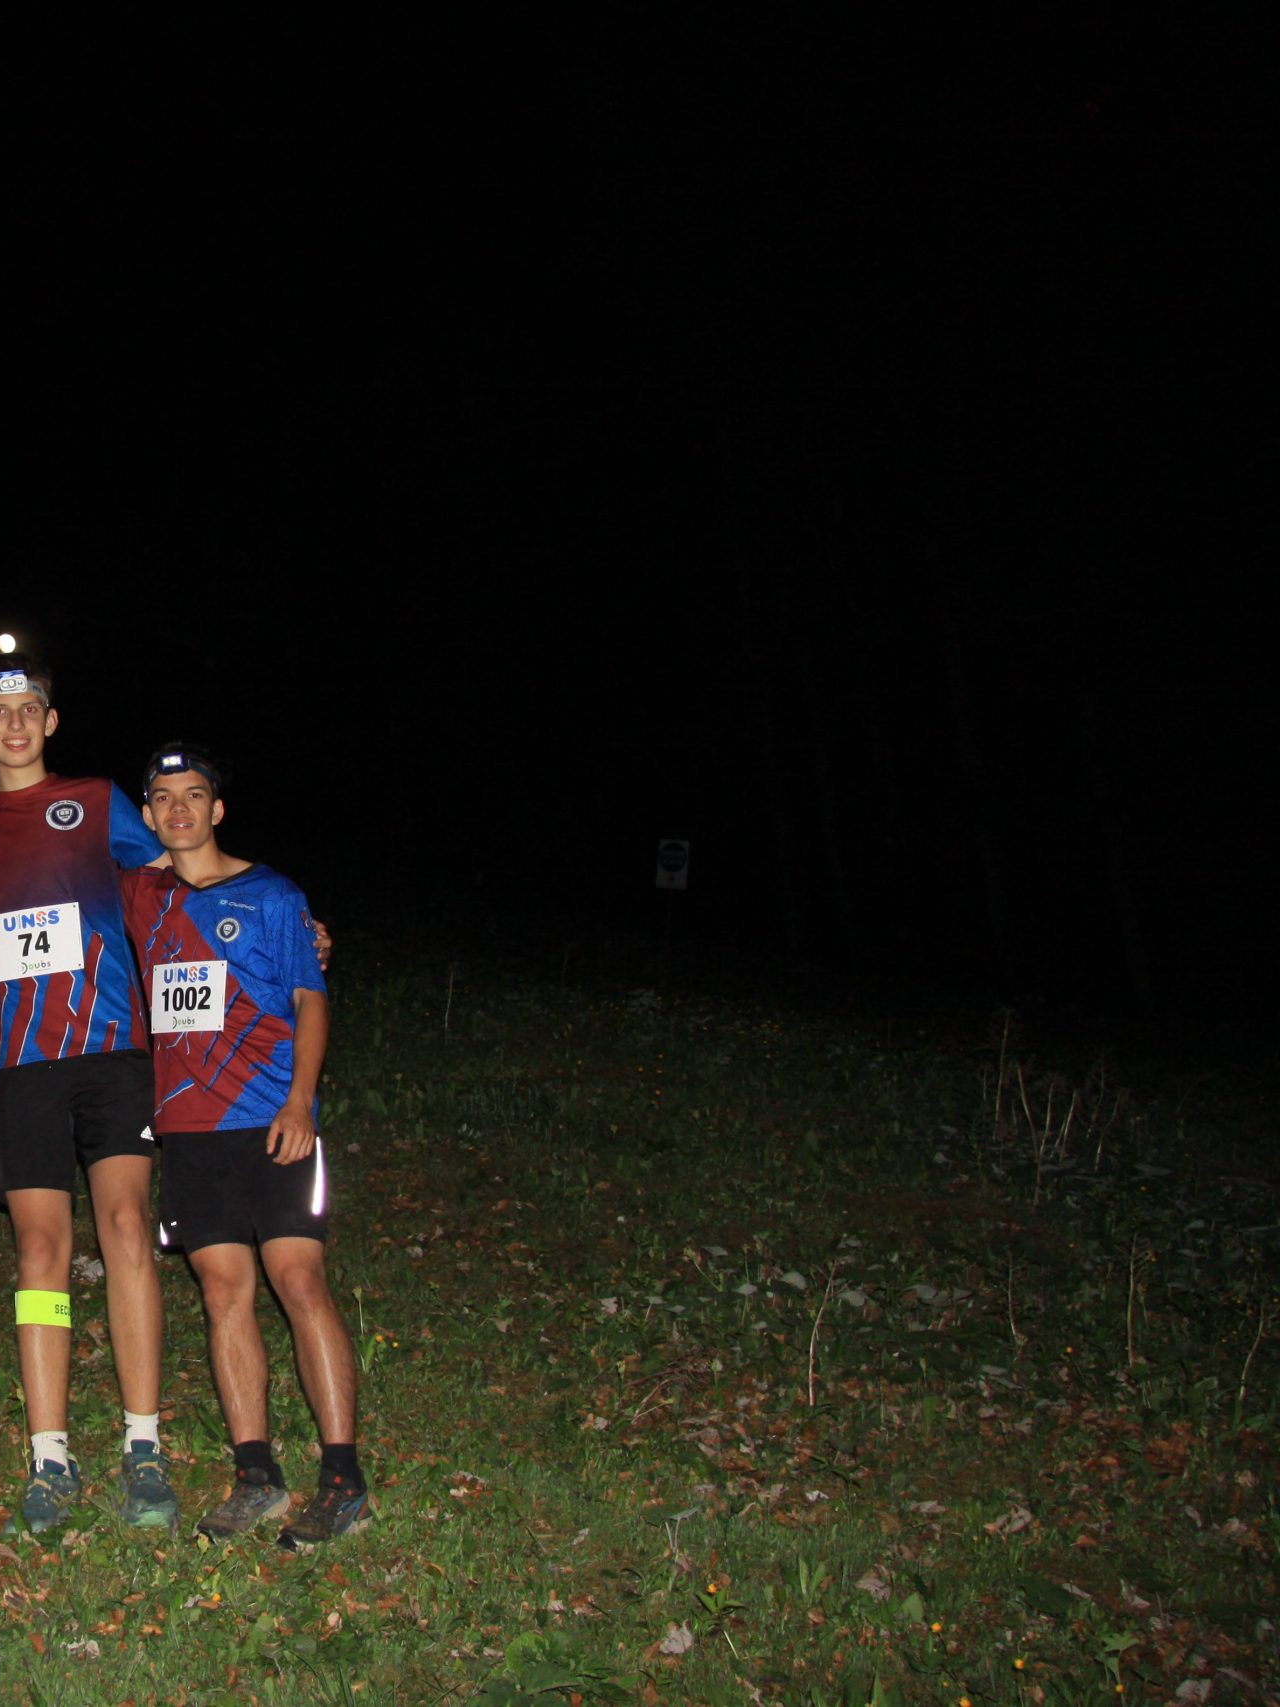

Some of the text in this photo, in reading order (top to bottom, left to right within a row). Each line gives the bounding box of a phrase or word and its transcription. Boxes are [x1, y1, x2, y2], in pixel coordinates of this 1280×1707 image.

[3, 909, 60, 932] UNSS
[17, 930, 51, 957] 74
[163, 965, 209, 984] UNSS
[161, 985, 211, 1012] 1002
